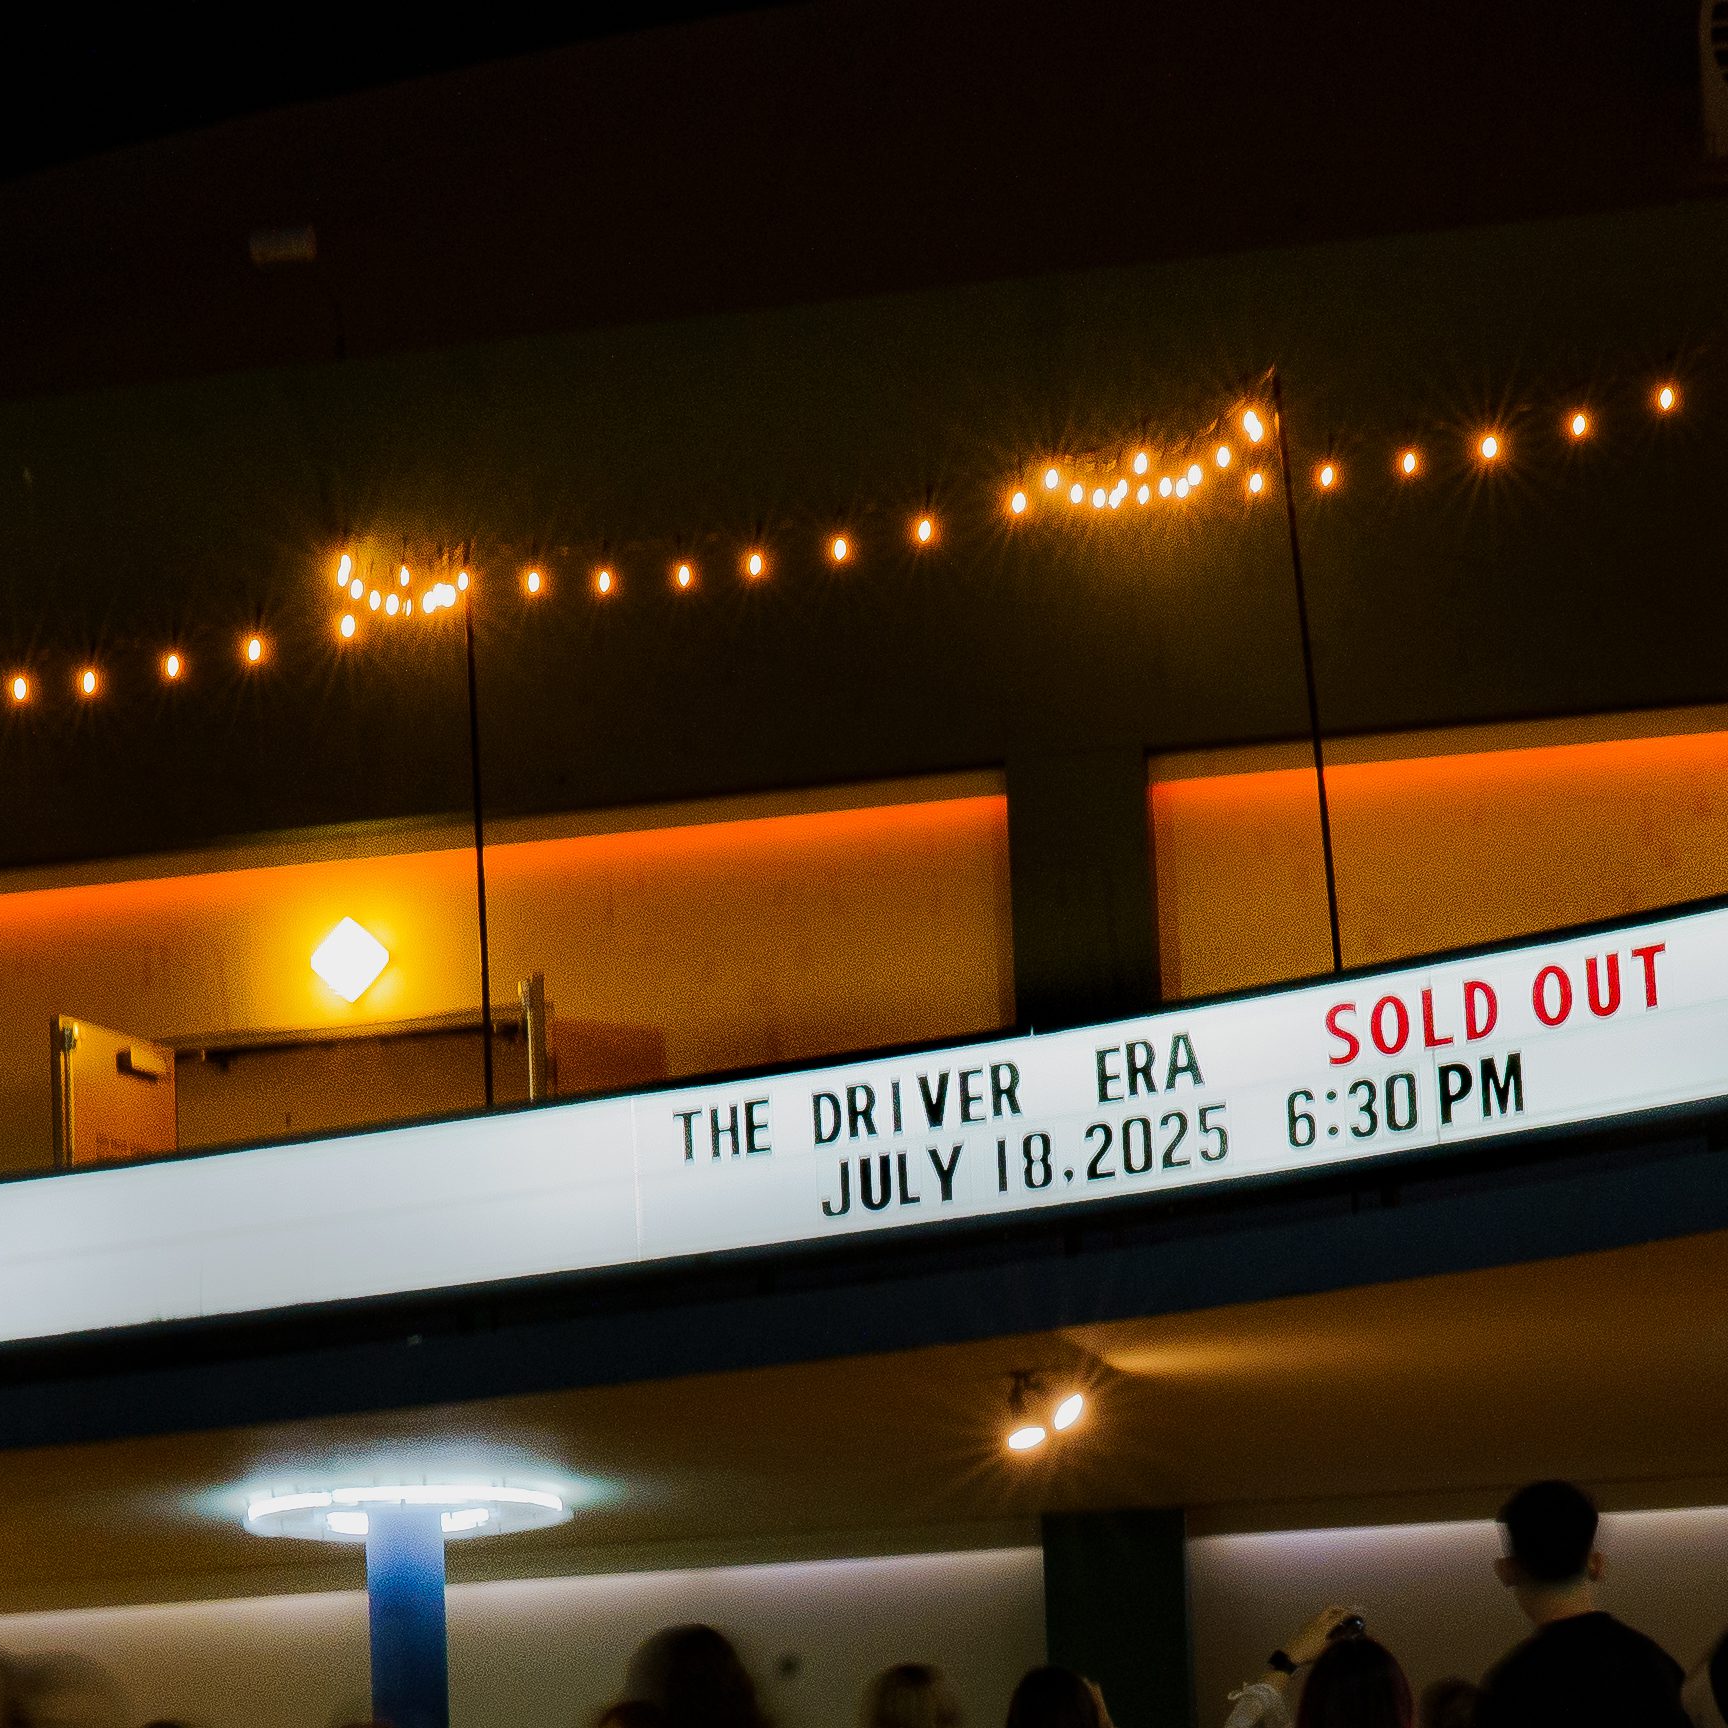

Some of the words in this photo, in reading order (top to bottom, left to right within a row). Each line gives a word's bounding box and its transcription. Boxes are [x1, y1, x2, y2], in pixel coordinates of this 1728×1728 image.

[672, 1098, 773, 1162] THE
[812, 1062, 1022, 1145] DRIVER
[1095, 1032, 1205, 1105] ERA
[1325, 980, 1499, 1066] SOLD
[1532, 942, 1667, 1027] OUT
[820, 1144, 964, 1217] JULY
